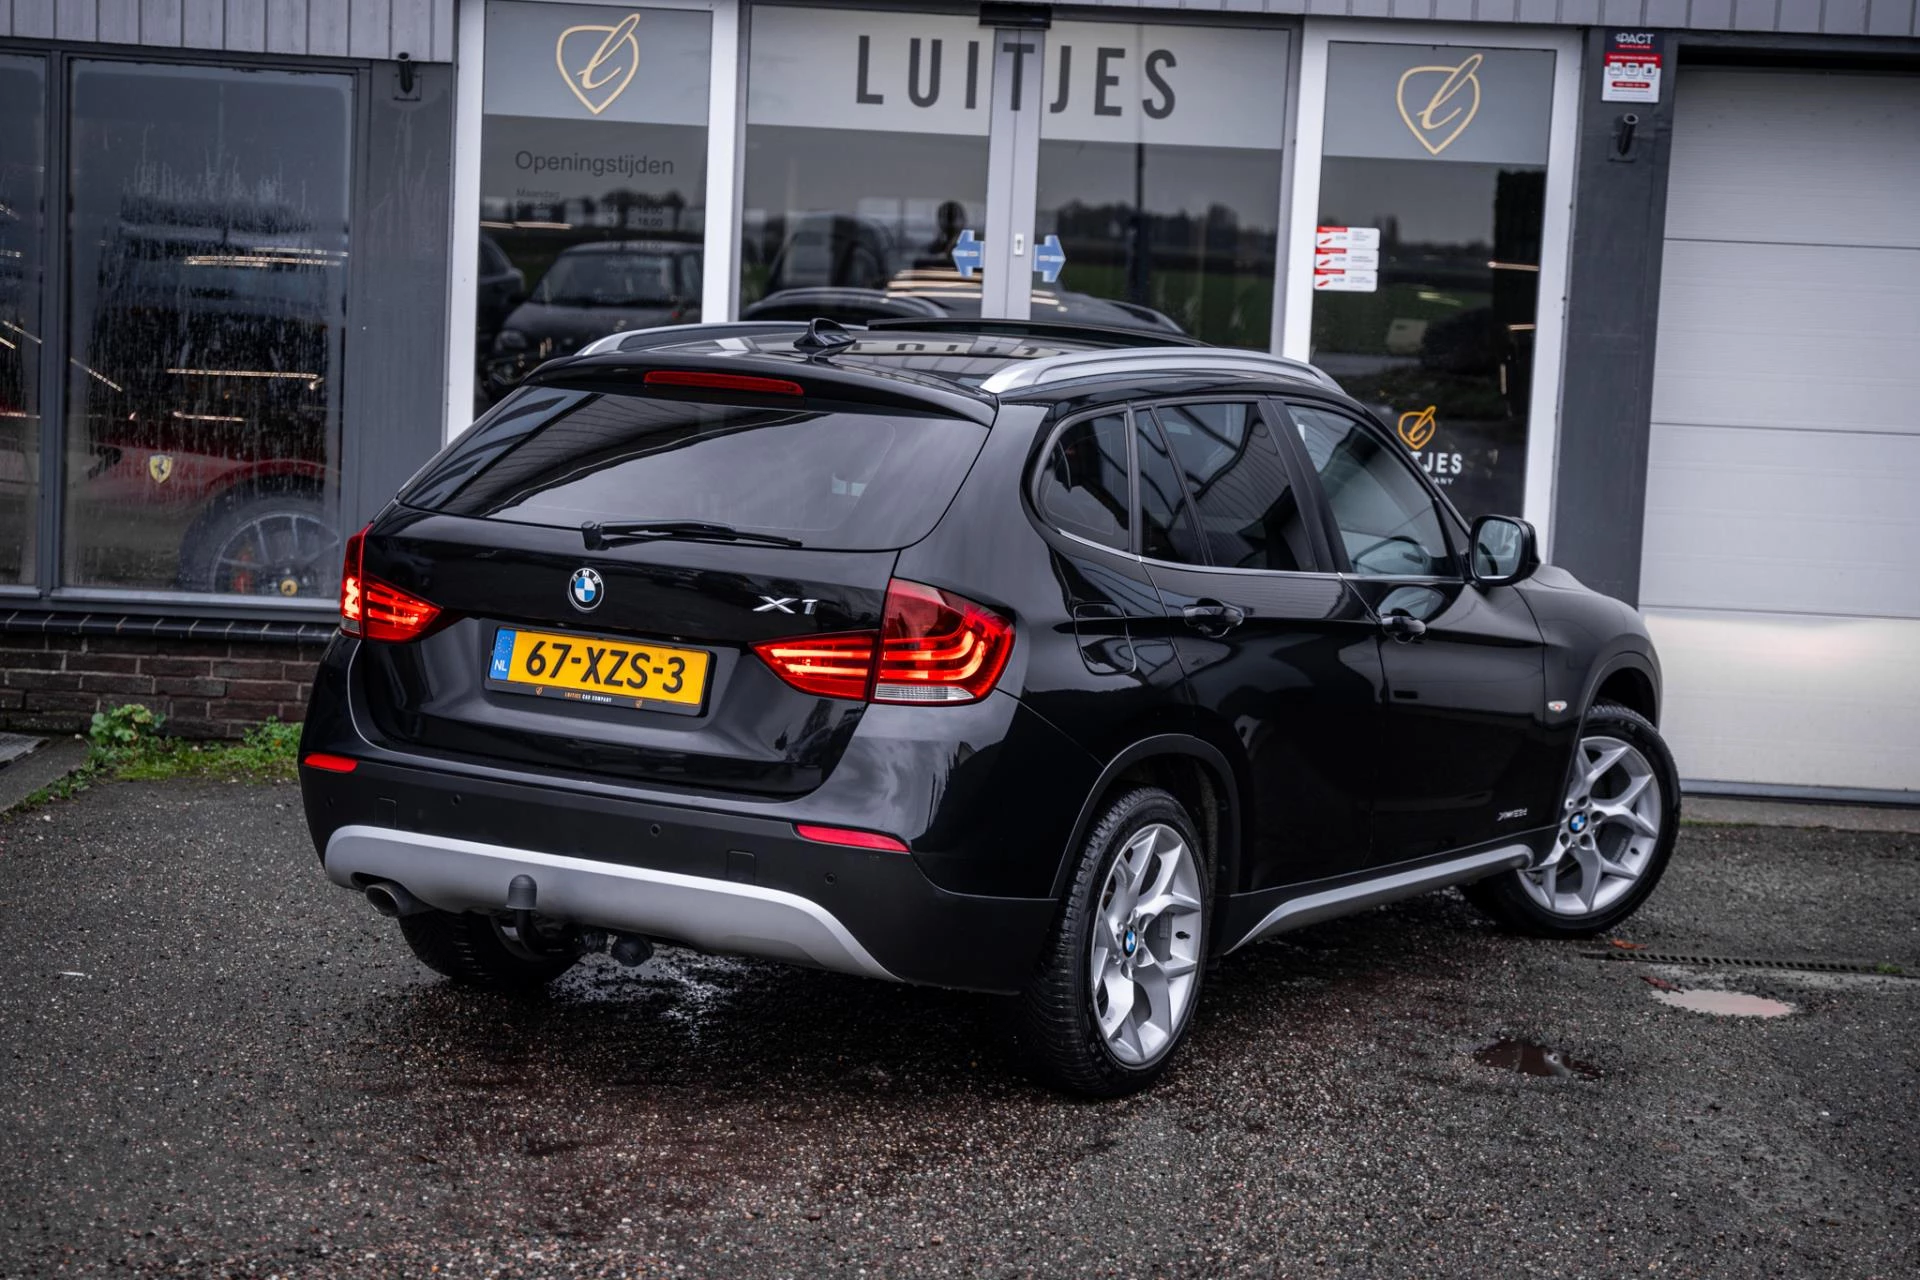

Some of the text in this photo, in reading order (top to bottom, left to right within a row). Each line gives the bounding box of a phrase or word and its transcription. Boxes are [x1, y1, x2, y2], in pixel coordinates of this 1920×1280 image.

[856, 35, 1177, 120] LUITJES
[515, 150, 674, 178] Openingstijden
[752, 595, 819, 615] X1
[494, 659, 508, 673] NL
[524, 640, 687, 694] 67-XZS-3
